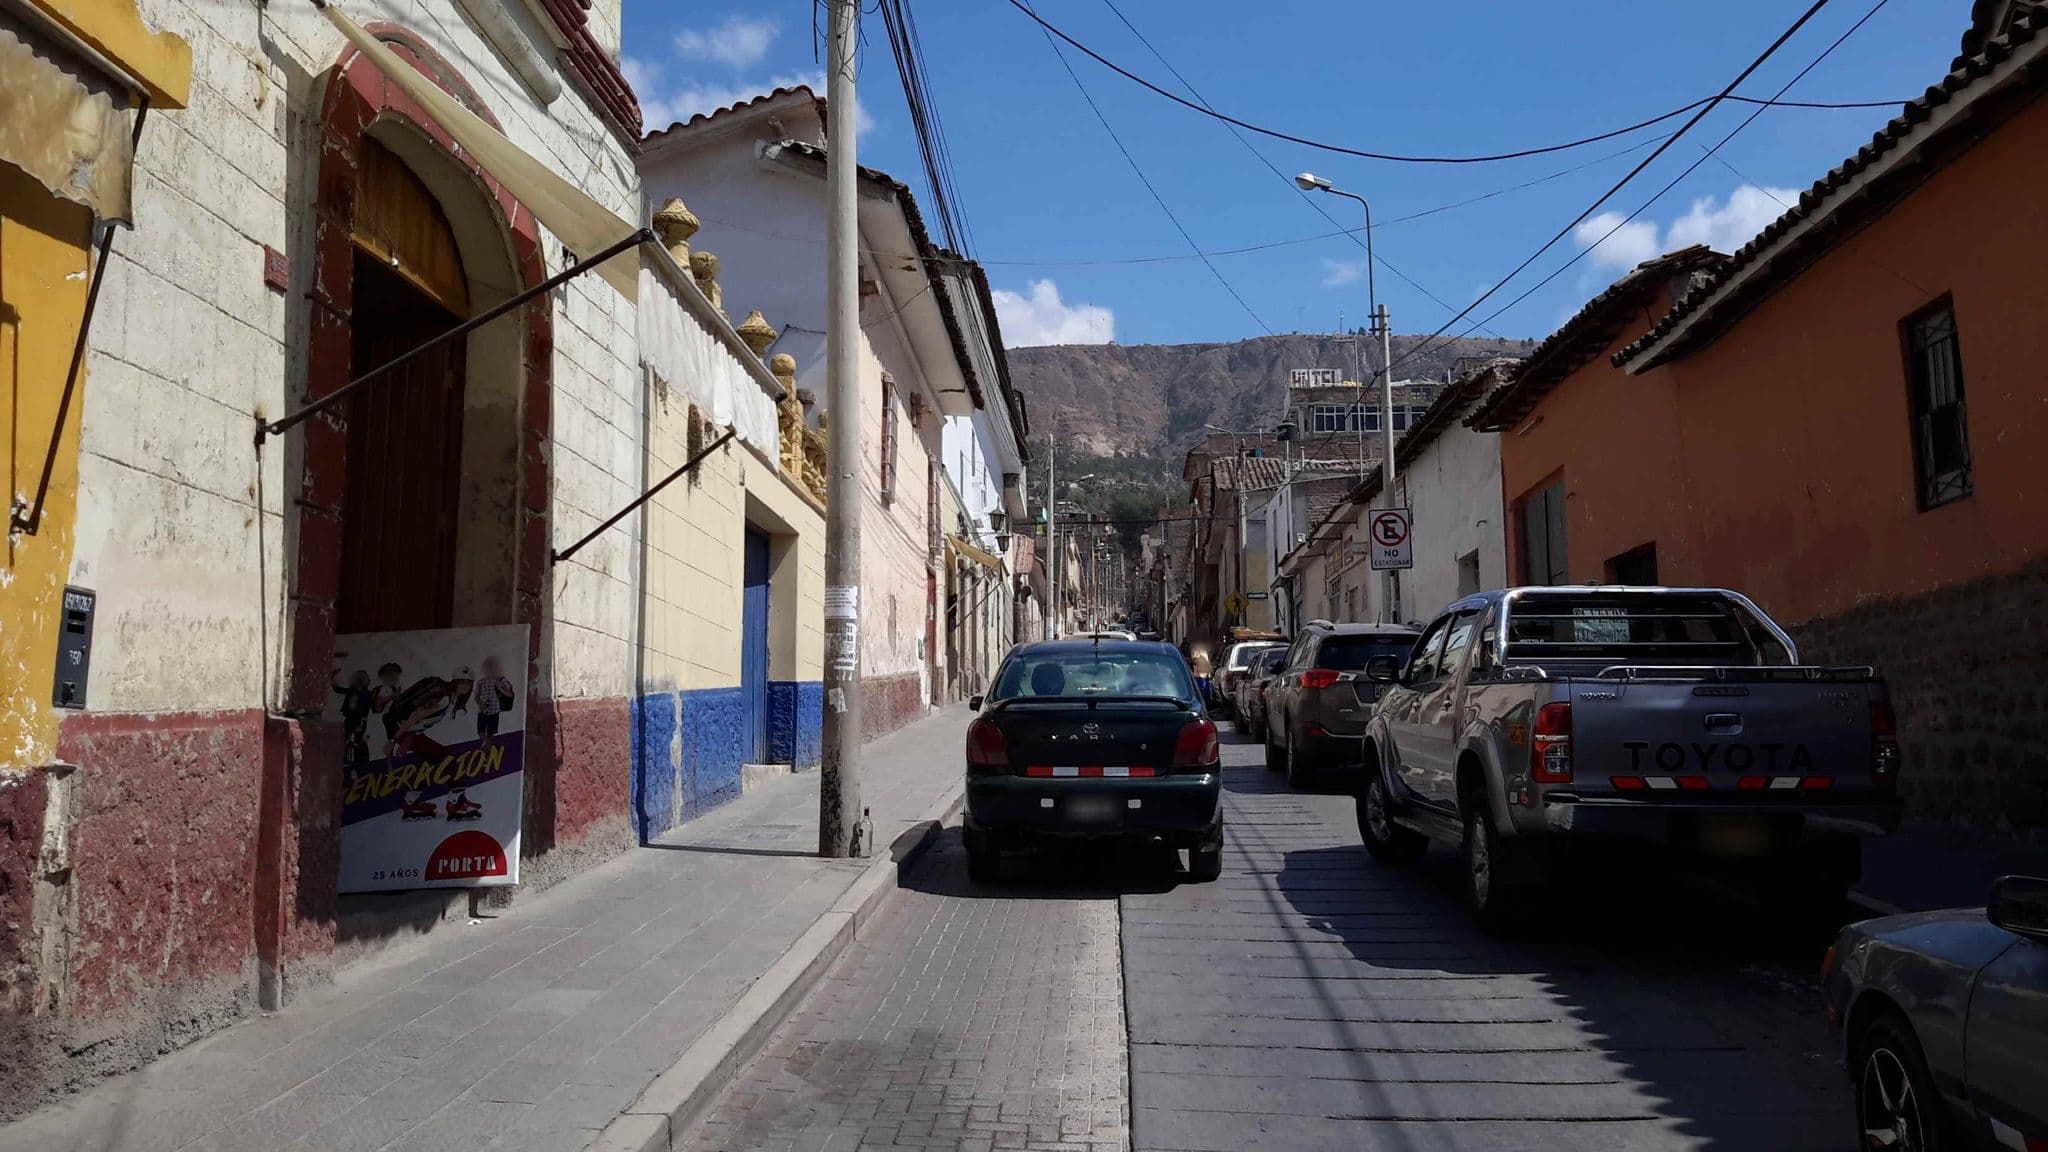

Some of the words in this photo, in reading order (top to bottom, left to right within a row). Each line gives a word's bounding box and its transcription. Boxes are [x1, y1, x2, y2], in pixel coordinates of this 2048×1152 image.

[1384, 549, 1399, 558] NO
[1624, 742, 1817, 770] TOYOTA
[344, 744, 505, 805] ENERACION
[438, 856, 496, 873] PORTA
[372, 871, 385, 880] 25
[390, 868, 419, 879] AÑOS
